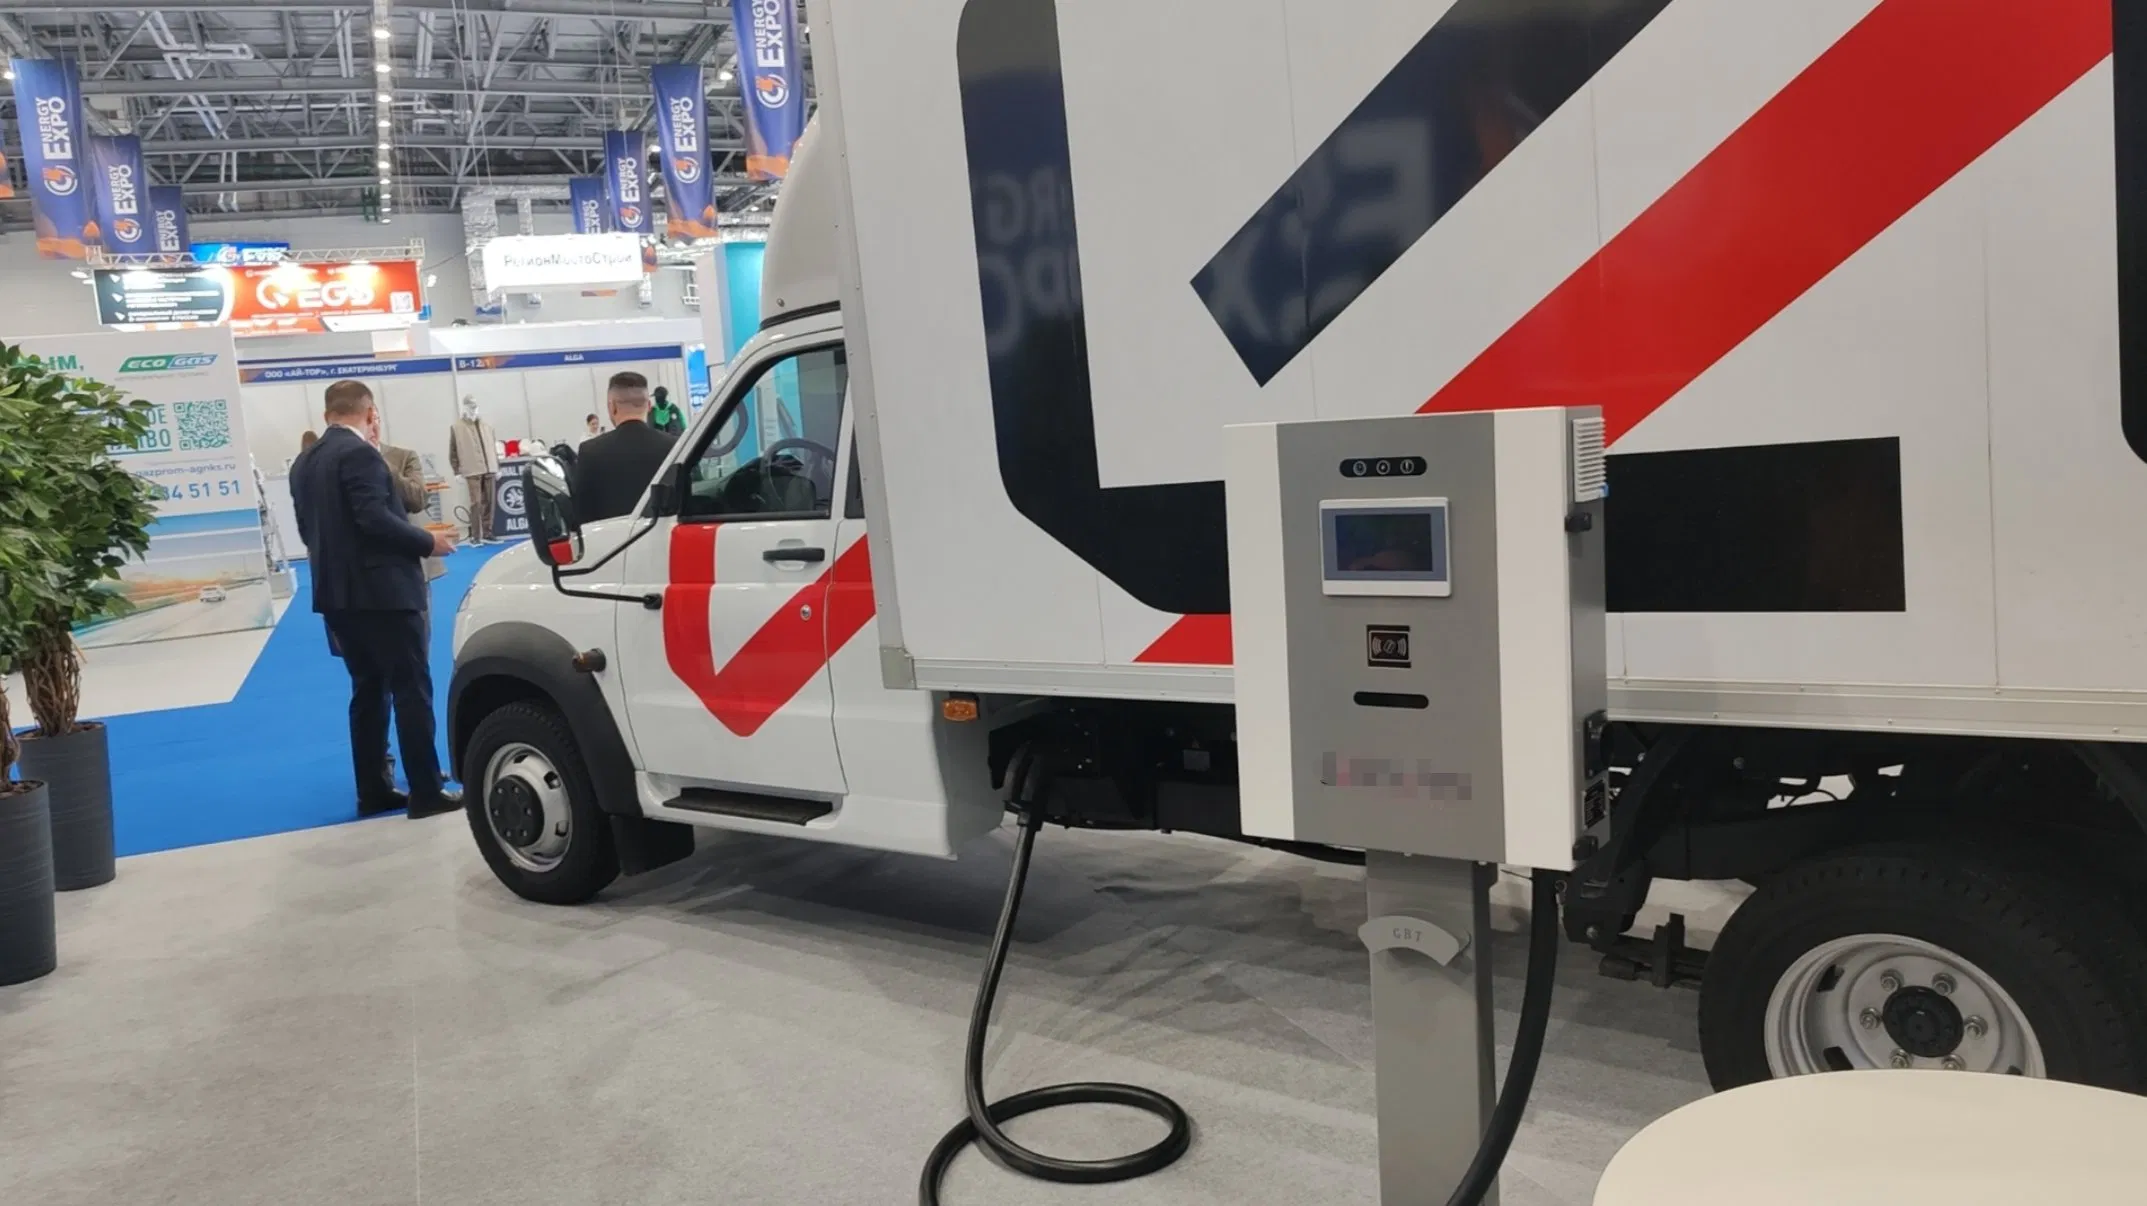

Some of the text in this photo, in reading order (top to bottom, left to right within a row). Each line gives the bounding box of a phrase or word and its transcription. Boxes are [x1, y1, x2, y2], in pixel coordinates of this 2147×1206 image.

[757, 0, 785, 68] EXPO
[44, 96, 73, 160] EXPO
[675, 96, 698, 153] EXPO
[114, 164, 139, 215] EXPO
[621, 157, 640, 203] EXPO
[160, 209, 180, 251] EXPO
[264, 370, 284, 379] ООО
[337, 363, 399, 375] ЕКАТЕРИНБУРГ
[563, 353, 585, 362] ALGA
[188, 482, 211, 499] 51
[218, 480, 240, 496] 51
